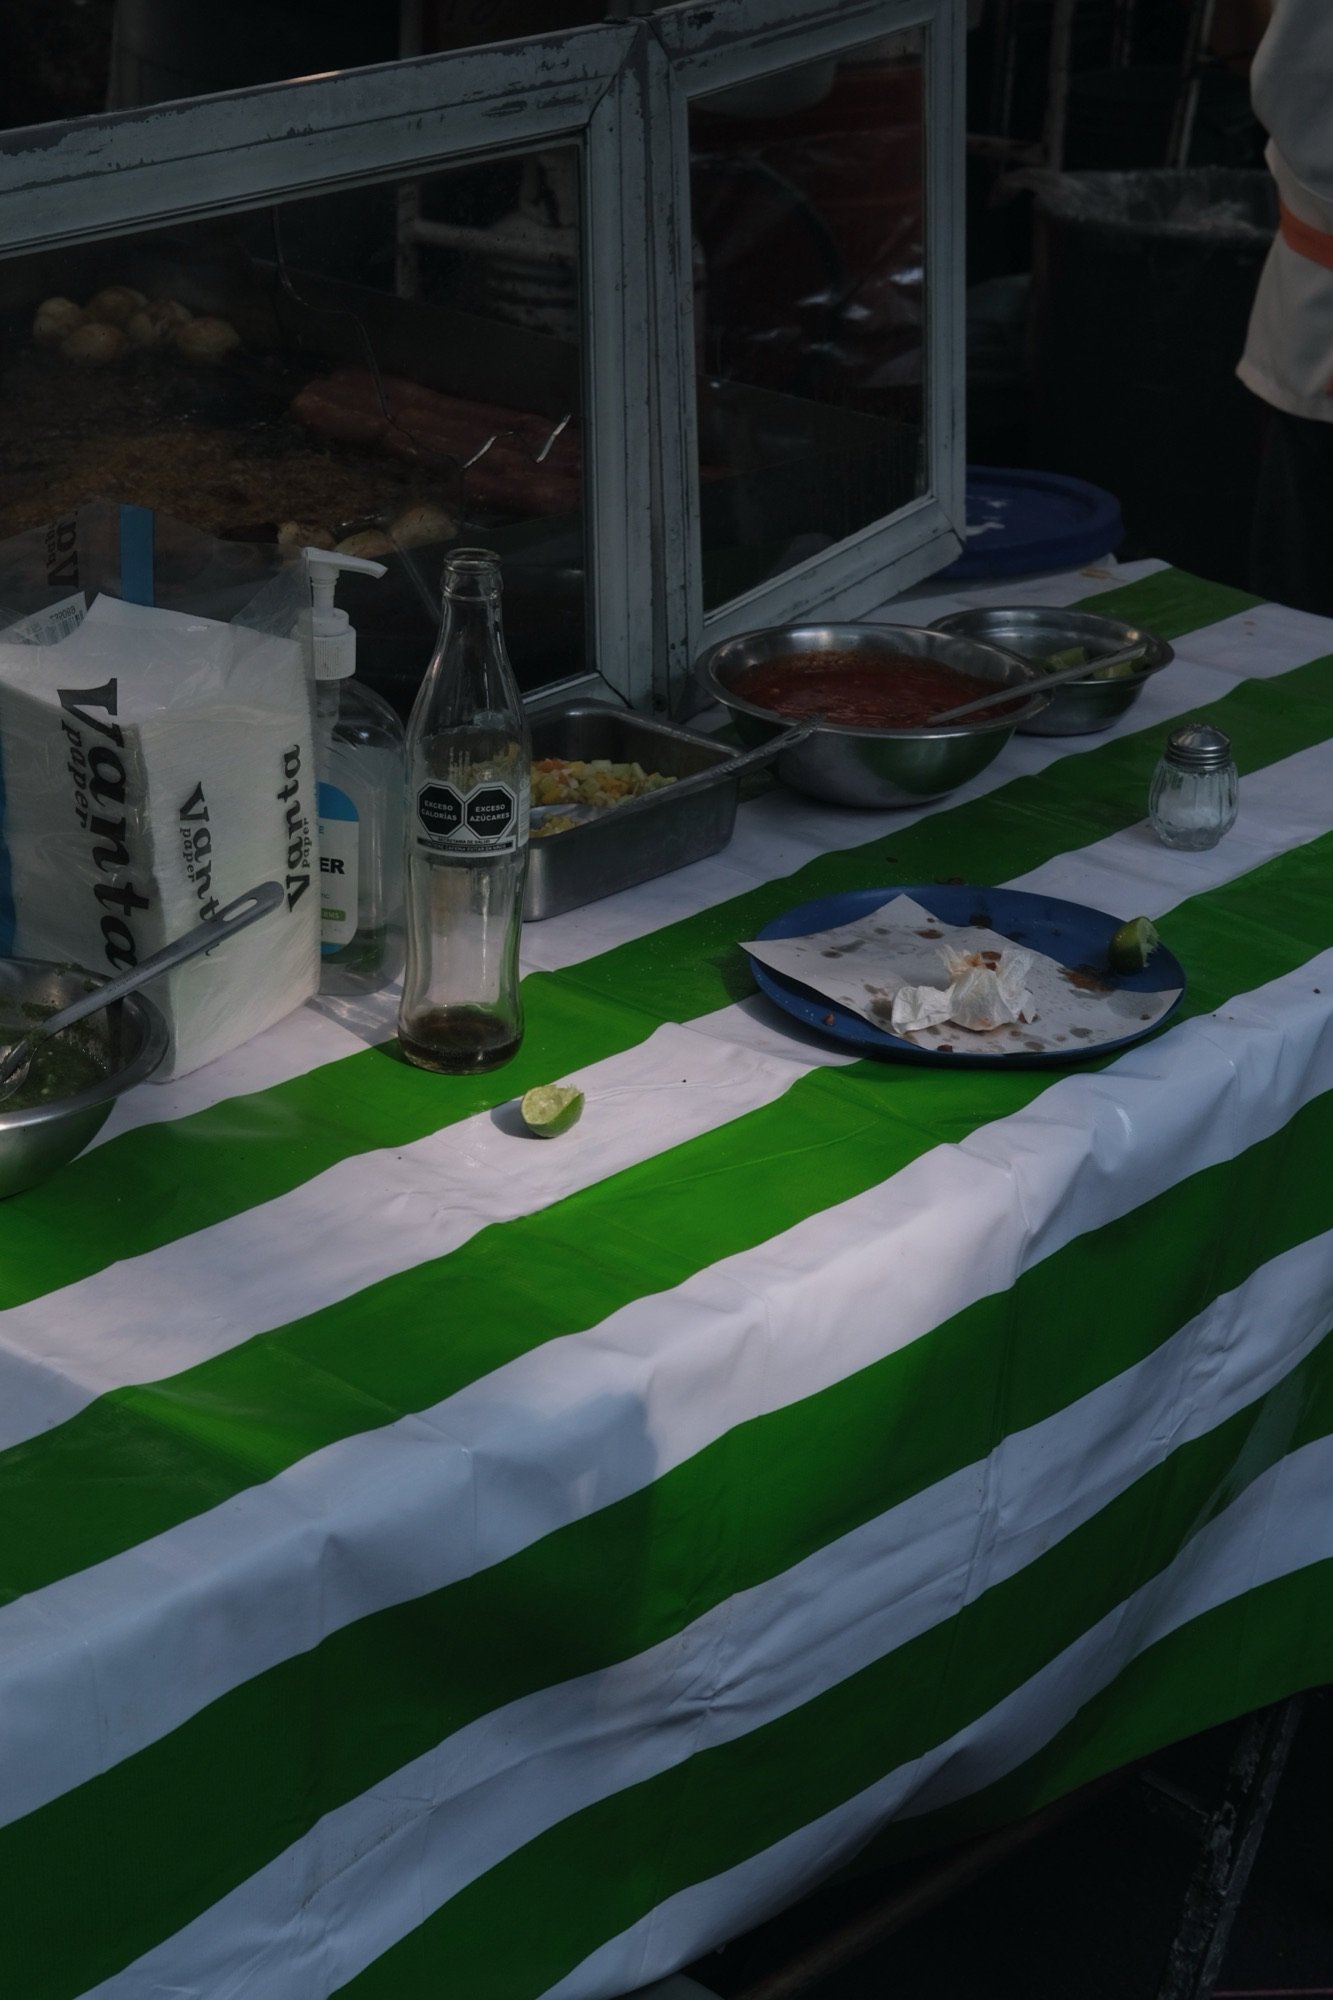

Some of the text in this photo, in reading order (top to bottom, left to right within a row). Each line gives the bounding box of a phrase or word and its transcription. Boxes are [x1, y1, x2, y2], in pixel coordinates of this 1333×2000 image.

[61, 719, 89, 829] paper
[57, 678, 149, 971] Vanta
[277, 744, 310, 912] Vanta
[421, 808, 458, 821] CALORÍAS
[424, 800, 454, 812] EXCESO
[469, 812, 510, 823] AZÚCARES
[475, 804, 506, 813] EXCESO
[179, 827, 196, 882] paper
[302, 818, 312, 869] paper
